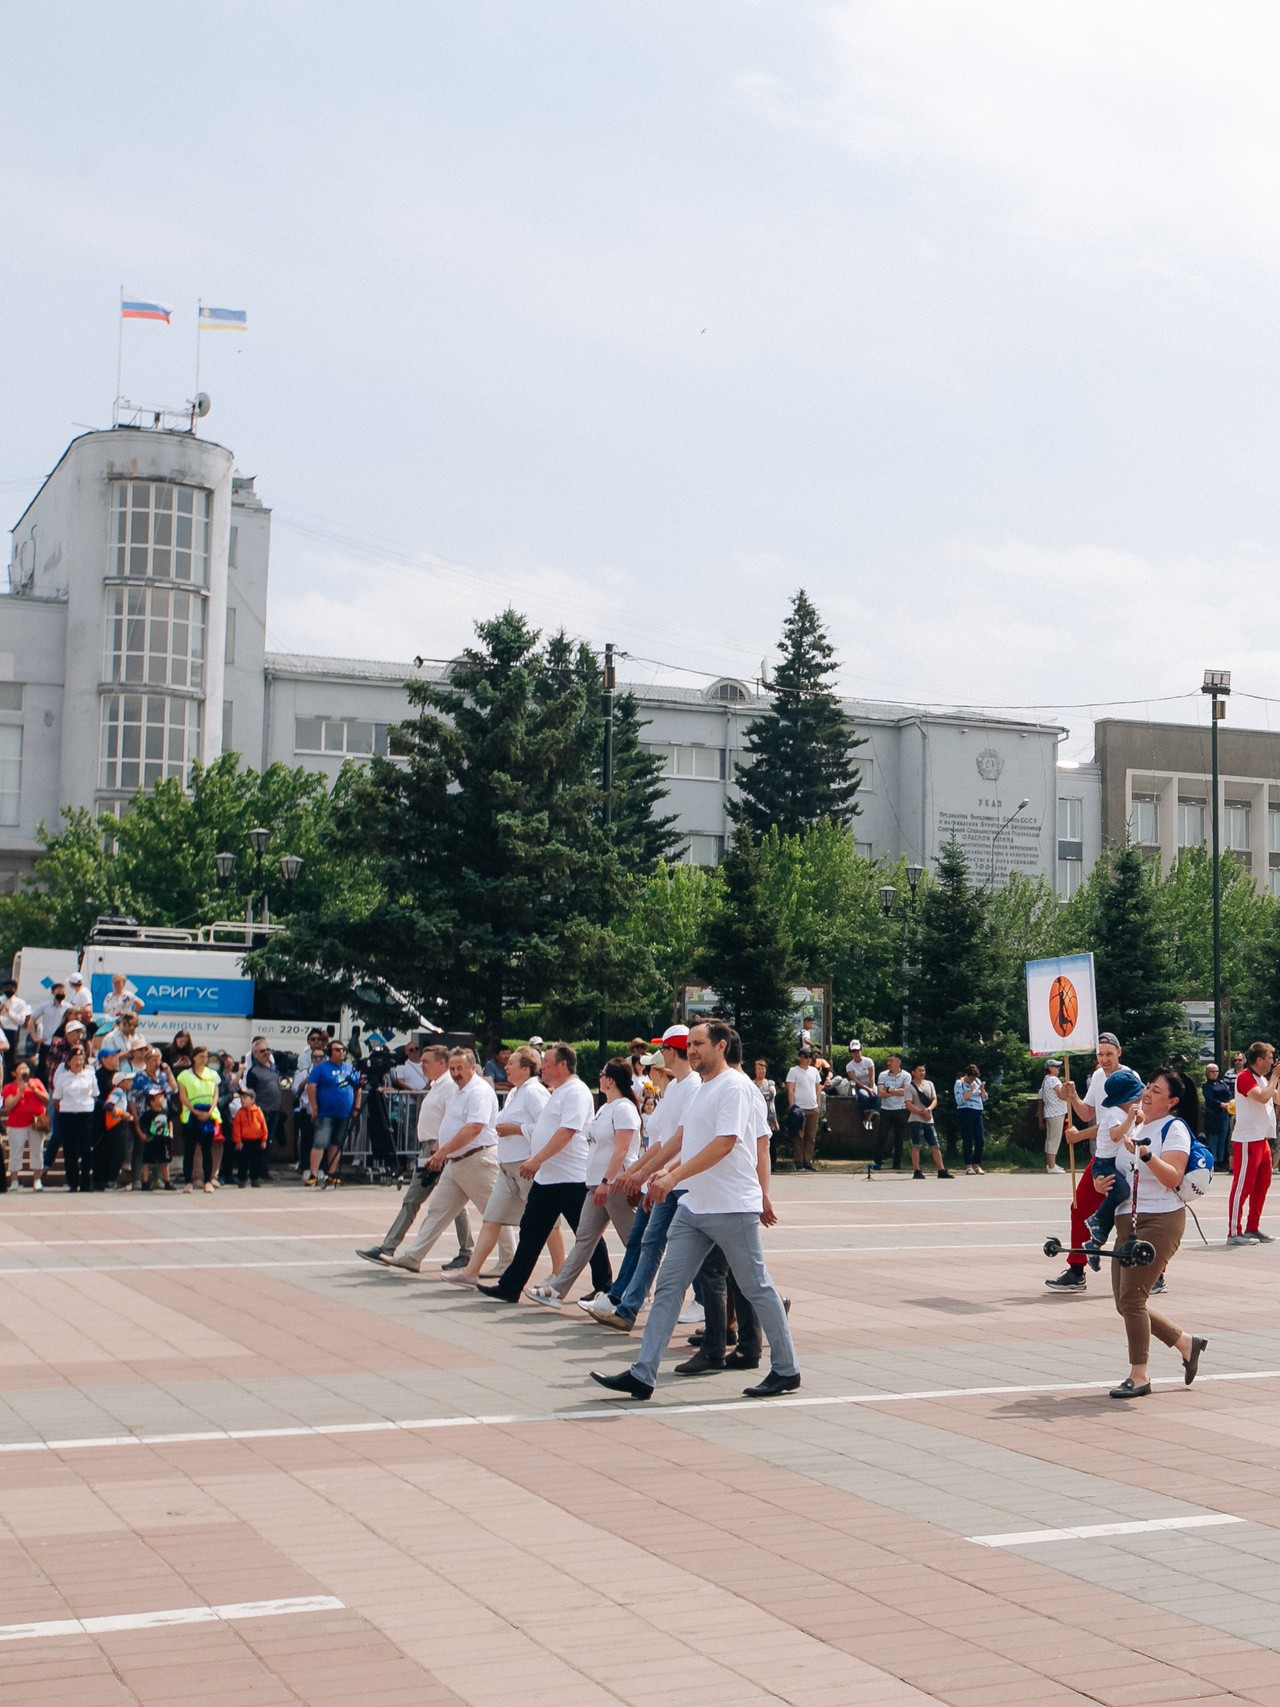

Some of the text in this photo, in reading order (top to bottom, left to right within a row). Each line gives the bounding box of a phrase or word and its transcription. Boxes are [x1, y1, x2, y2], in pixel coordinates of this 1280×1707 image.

[978, 798, 1002, 808] УКАЗ
[146, 984, 219, 1000] АРИГУС
[138, 1020, 220, 1031] WW.ARIGUS.TV
